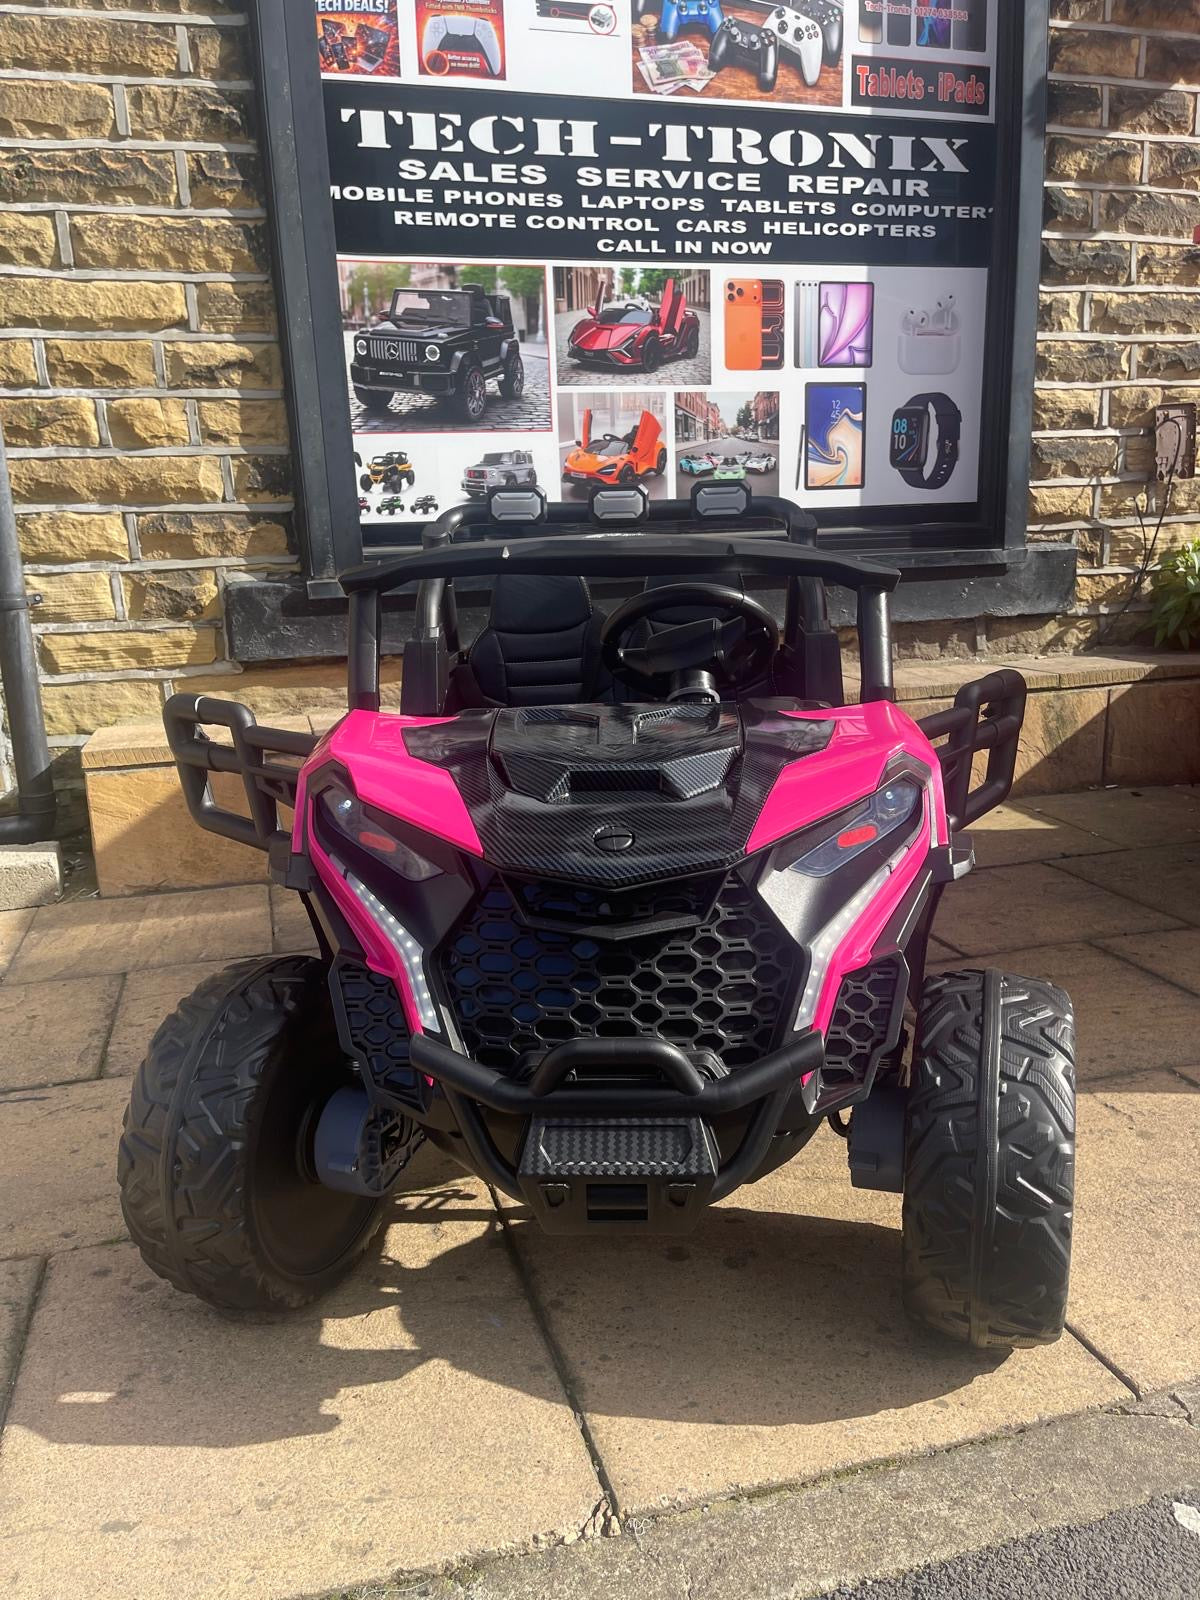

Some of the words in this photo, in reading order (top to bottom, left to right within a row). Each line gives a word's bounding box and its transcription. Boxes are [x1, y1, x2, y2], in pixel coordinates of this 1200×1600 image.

[315, 0, 342, 12] ECH
[344, 0, 389, 13] DEALS!
[857, 65, 924, 100] Tablets
[938, 72, 985, 104] iPads
[398, 159, 547, 185] SALES
[576, 166, 761, 191] SERVICE
[788, 175, 929, 197] REPAIR
[444, 190, 563, 207] PHONES
[582, 195, 704, 211] LAPTOPS
[721, 199, 835, 214] TABLETS
[852, 203, 993, 218] COMPUTER
[394, 211, 516, 228] REMOTE
[526, 215, 659, 231] CONTROL
[676, 219, 746, 233] CARS
[764, 221, 936, 237] HELICOPTERS
[597, 239, 666, 253] CALL
[676, 241, 702, 253] IN
[712, 242, 772, 254] NOW
[831, 399, 841, 410] 12
[830, 409, 841, 420] 45
[893, 418, 908, 433] 08
[894, 434, 907, 450] 10
